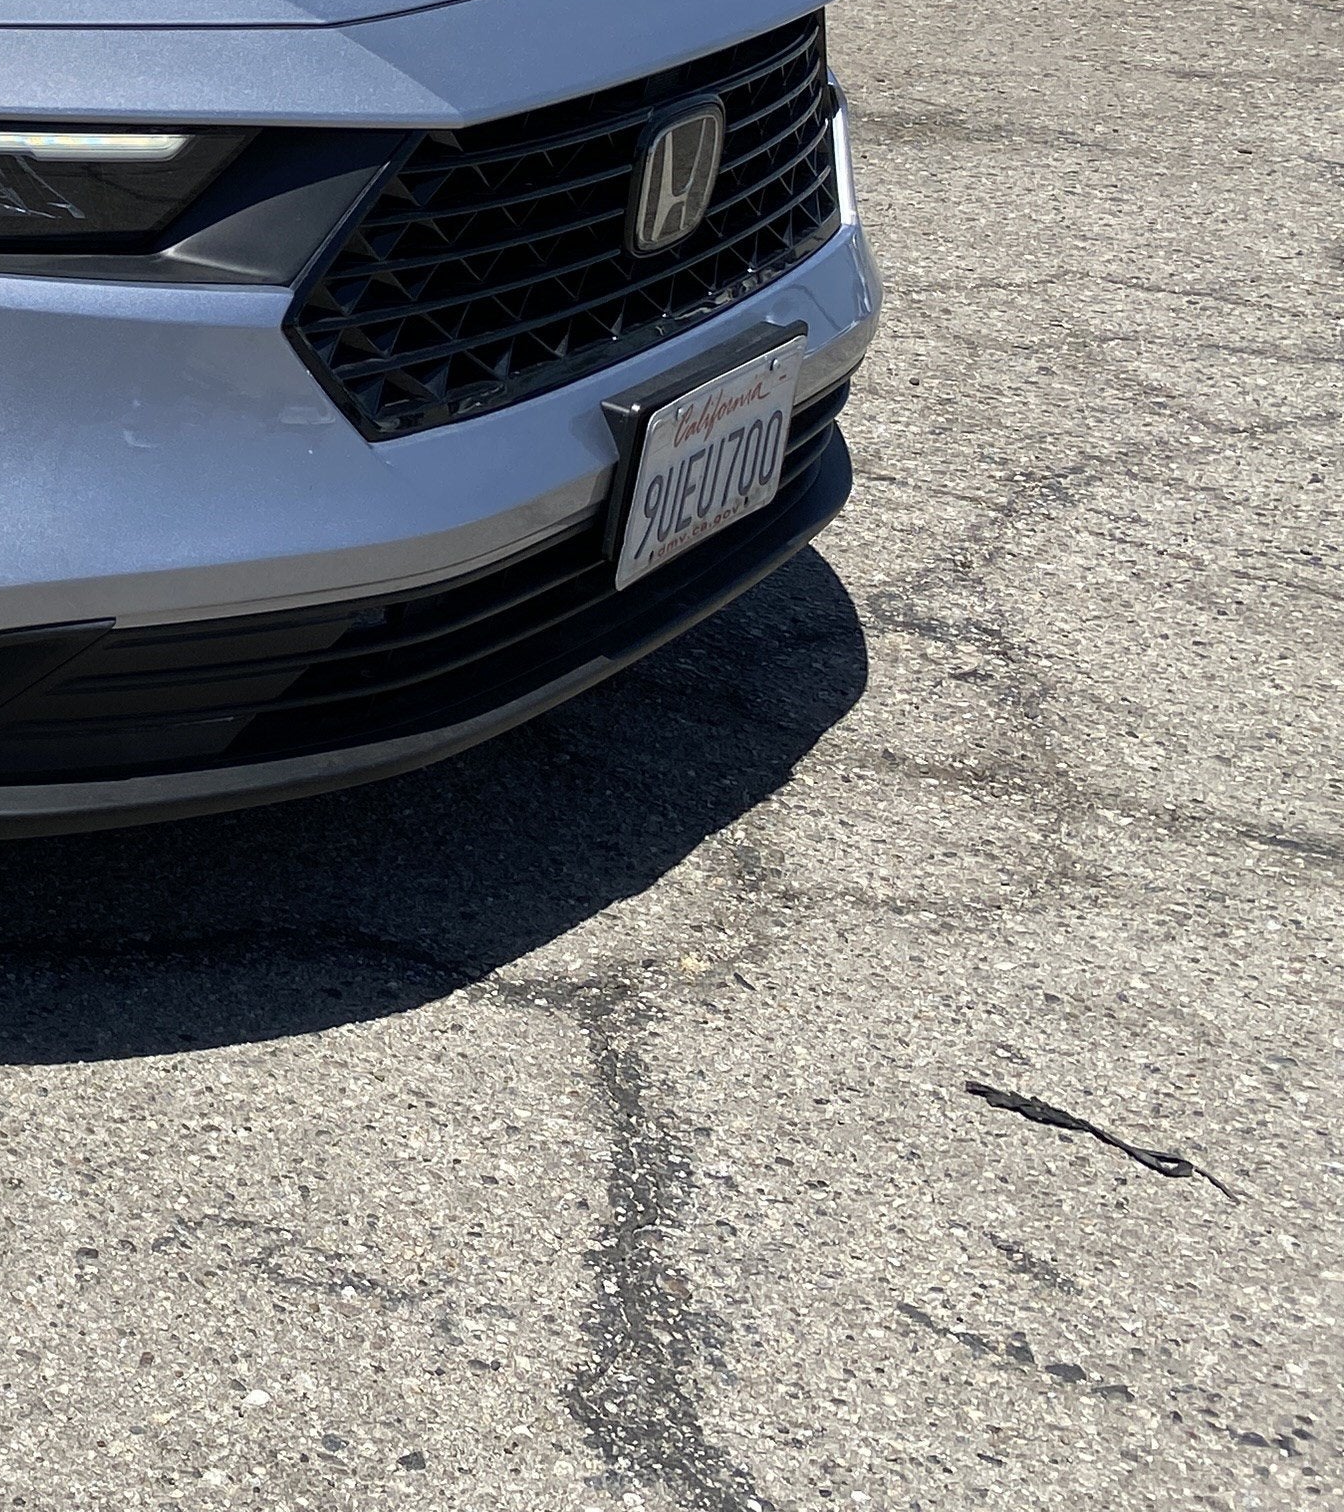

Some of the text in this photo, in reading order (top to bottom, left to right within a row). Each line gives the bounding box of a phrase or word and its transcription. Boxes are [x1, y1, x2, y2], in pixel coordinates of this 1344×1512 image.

[673, 374, 770, 448] California
[633, 409, 784, 560] 9UEU700
[657, 500, 740, 558] dmv.ca.gov
